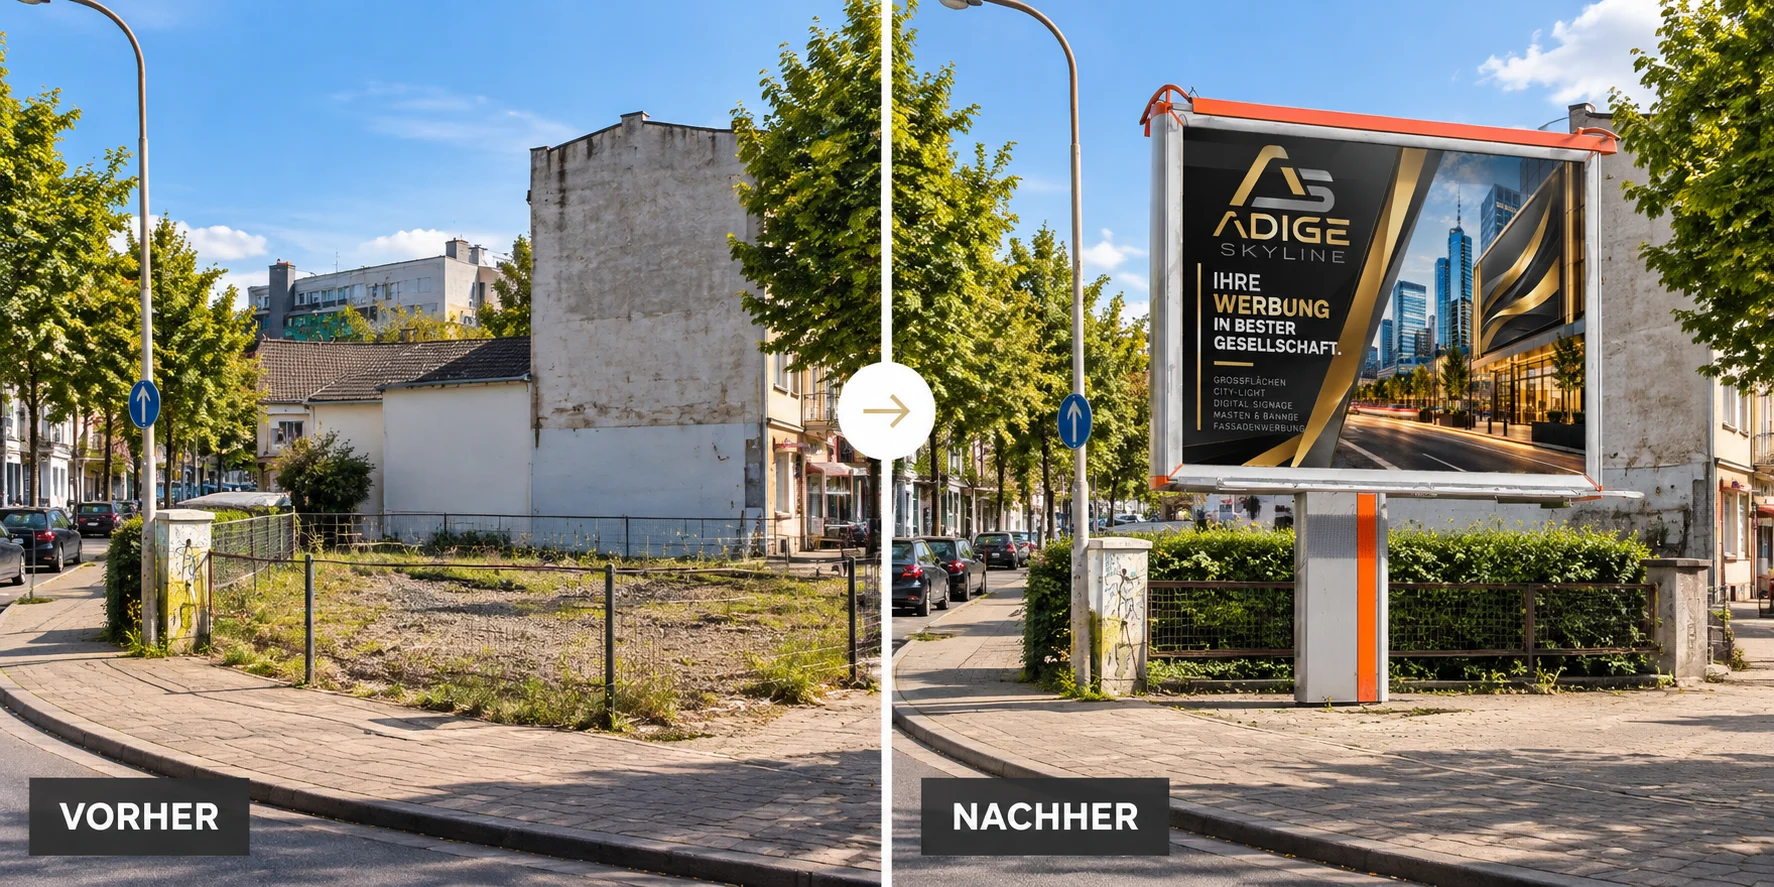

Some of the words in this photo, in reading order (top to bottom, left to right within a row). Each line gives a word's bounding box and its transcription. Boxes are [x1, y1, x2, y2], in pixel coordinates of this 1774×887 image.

[1212, 210, 1350, 246] ADIGE
[1220, 243, 1345, 264] SKYLINE
[1213, 271, 1261, 292] IHRE
[1213, 293, 1330, 319] WERBUNG
[1213, 317, 1230, 332] IN
[1234, 318, 1296, 335] BESTER
[1213, 335, 1342, 356] GESELLSCHAFT.
[1213, 387, 1266, 397] CITY-LIGHT
[1213, 399, 1249, 408] DIGITAL
[1252, 400, 1293, 410] SIGNAGE
[1213, 411, 1251, 420] MASTEN
[1213, 422, 1306, 433] FASSADENWERBUNG
